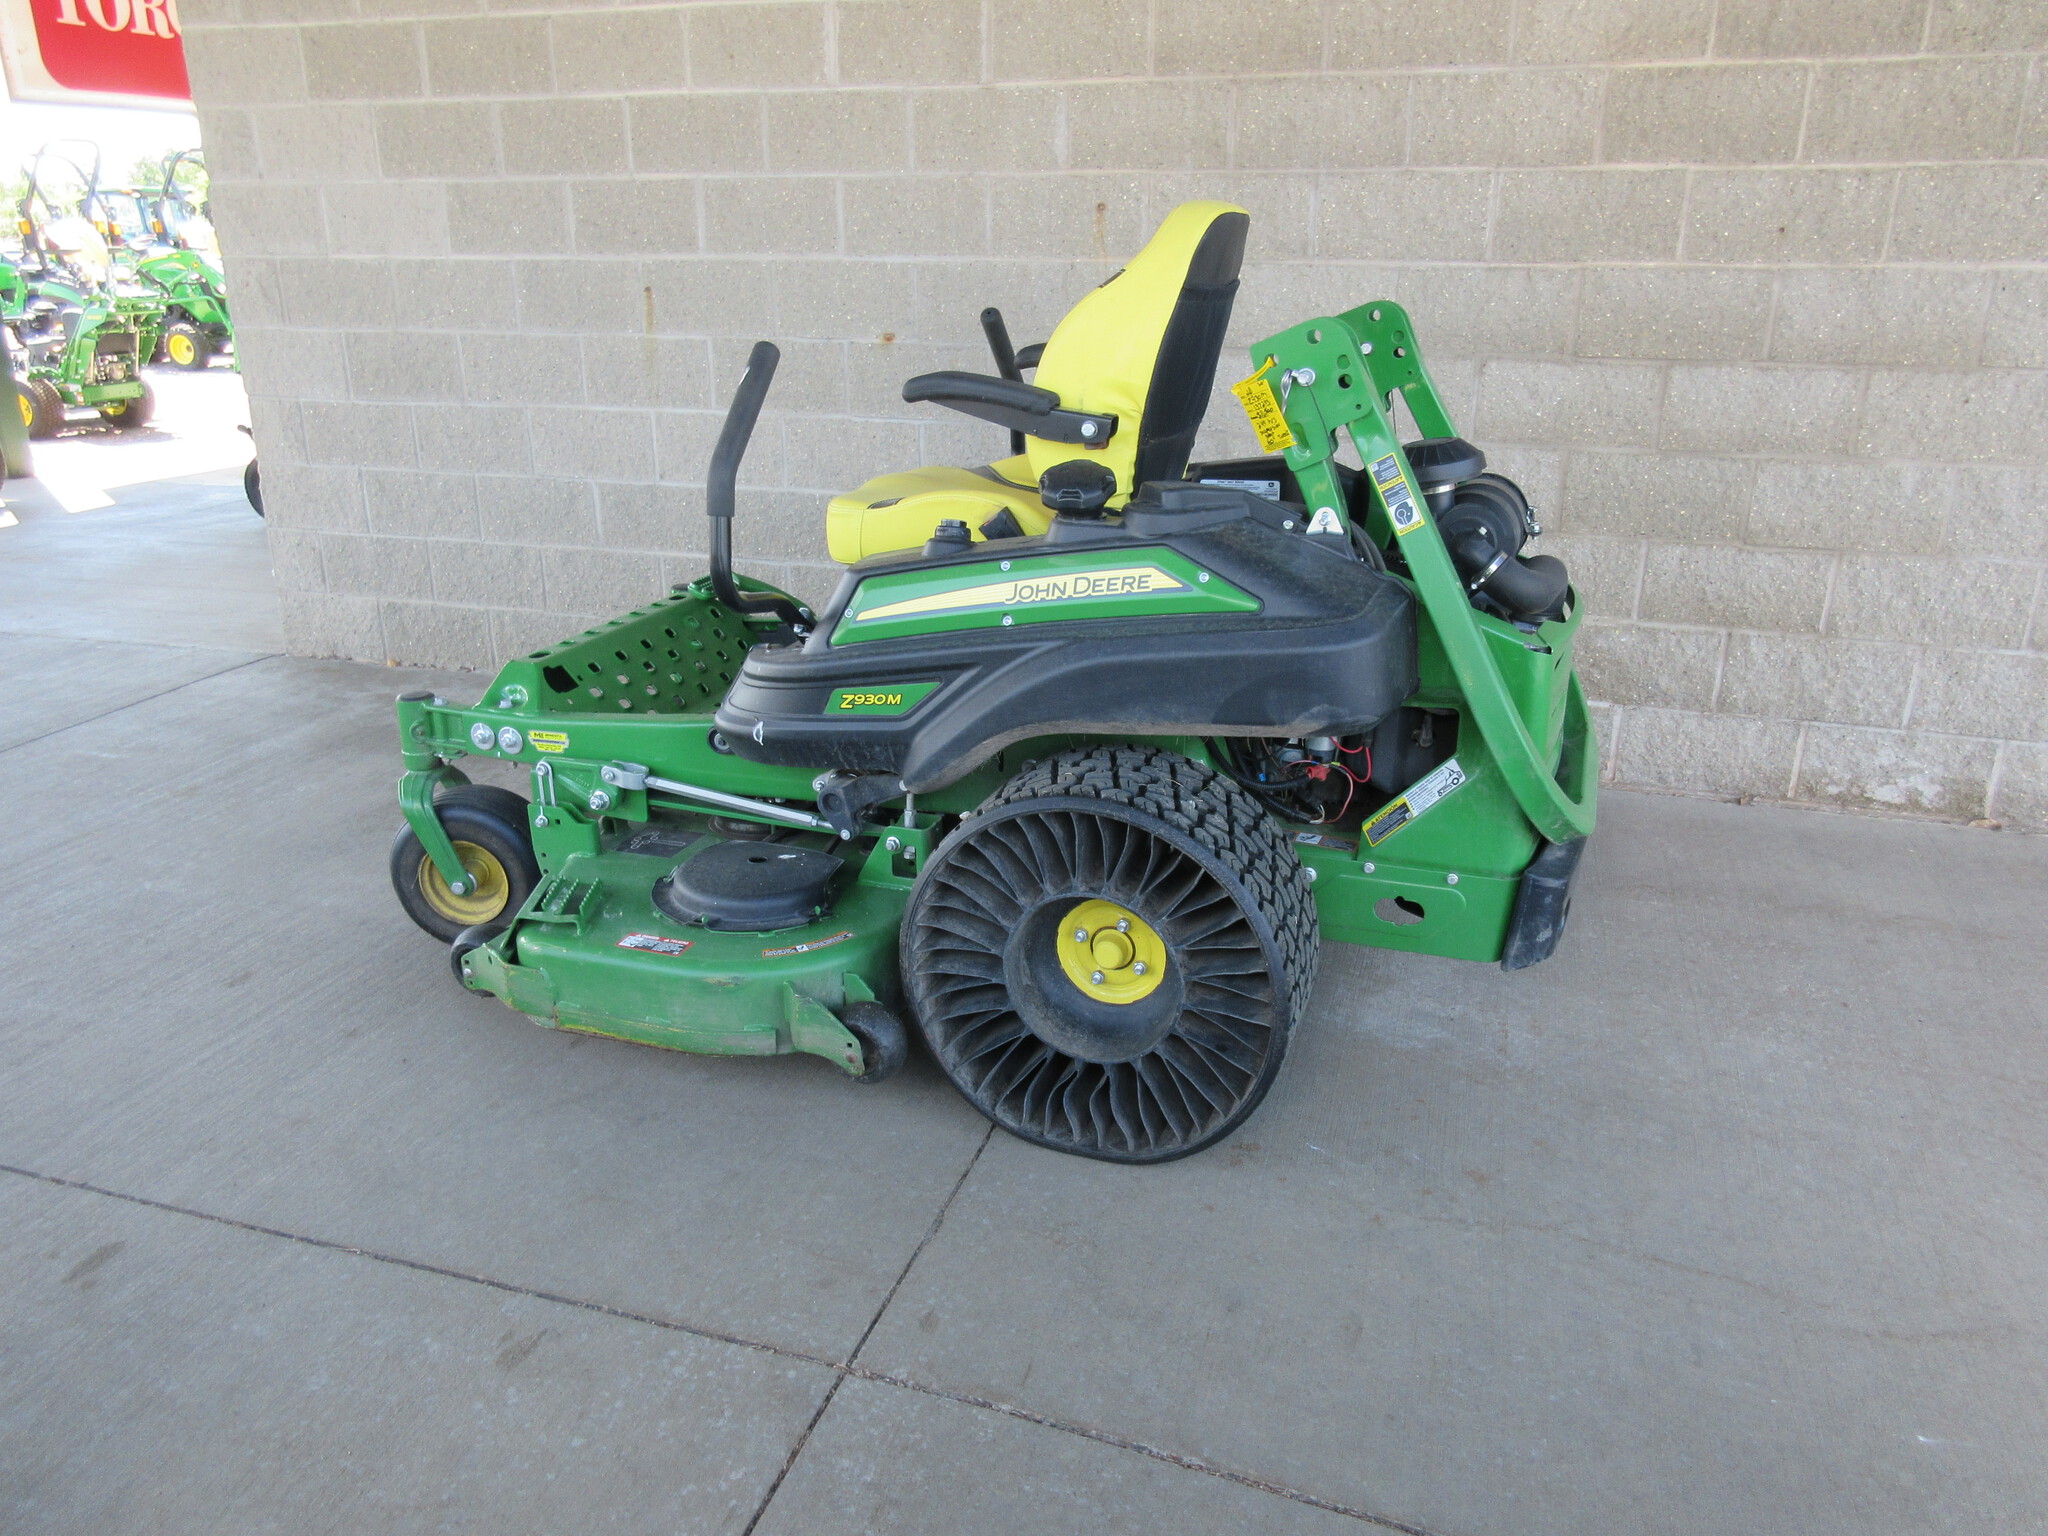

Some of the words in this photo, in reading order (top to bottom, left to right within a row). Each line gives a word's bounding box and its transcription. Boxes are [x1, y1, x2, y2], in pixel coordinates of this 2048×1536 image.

[1005, 581, 1068, 603] JOHN
[1072, 574, 1153, 596] DEERE
[840, 694, 902, 709] Z930M
